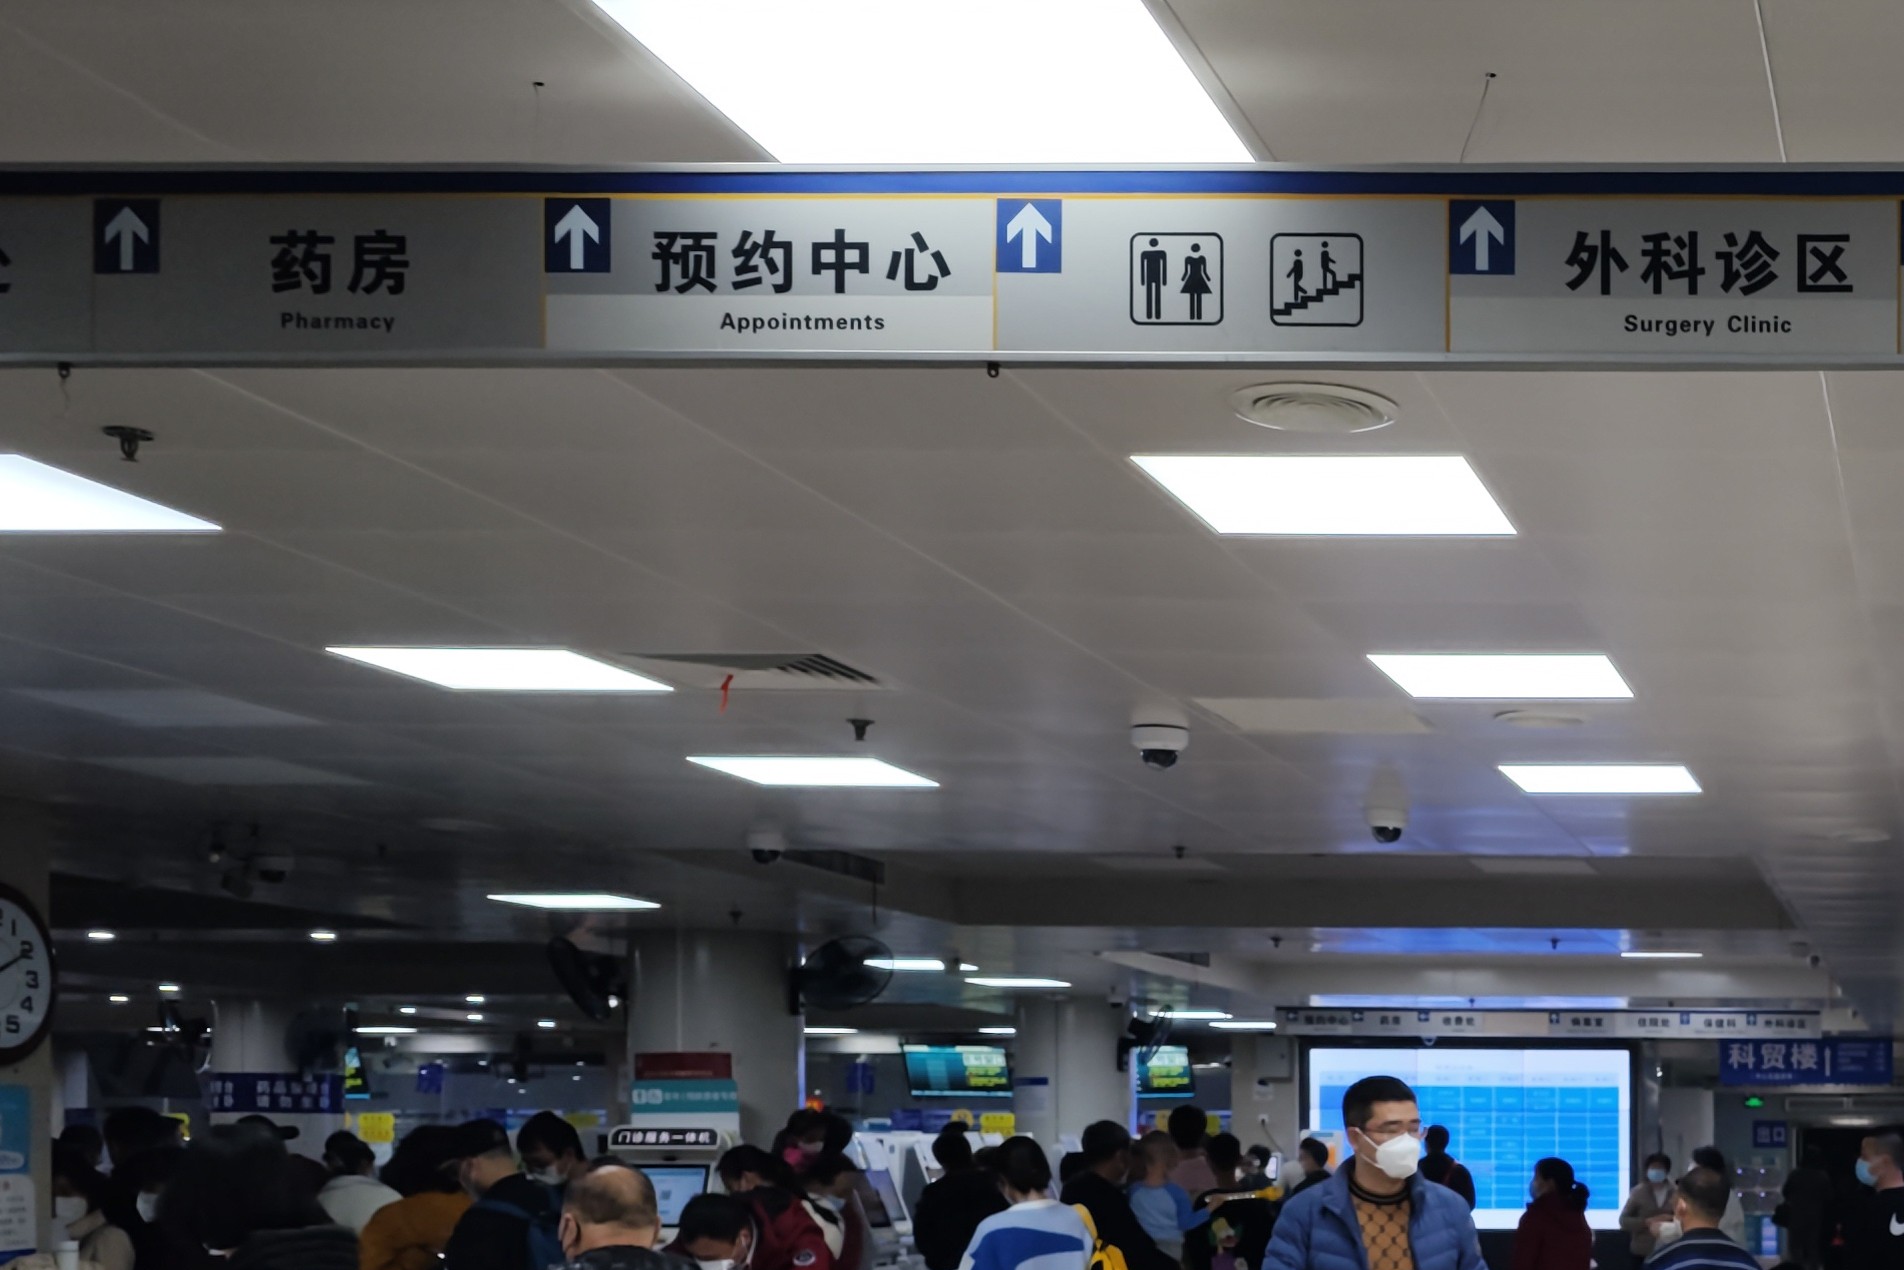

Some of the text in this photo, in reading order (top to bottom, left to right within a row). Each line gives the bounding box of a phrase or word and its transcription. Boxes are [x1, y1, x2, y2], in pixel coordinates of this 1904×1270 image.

[269, 229, 410, 296] 药房
[651, 228, 952, 296] 预约中心
[1564, 230, 1854, 296] 外科诊区
[280, 311, 396, 335] Pharmacy
[719, 310, 887, 335] Appointments
[1623, 313, 1793, 337] Surgery Clinic
[25, 971, 39, 989] 3
[20, 996, 34, 1013] 4
[6, 1015, 20, 1034] 5
[1727, 1042, 1819, 1070] 科贸楼
[616, 1129, 711, 1145] 门诊服务一体机
